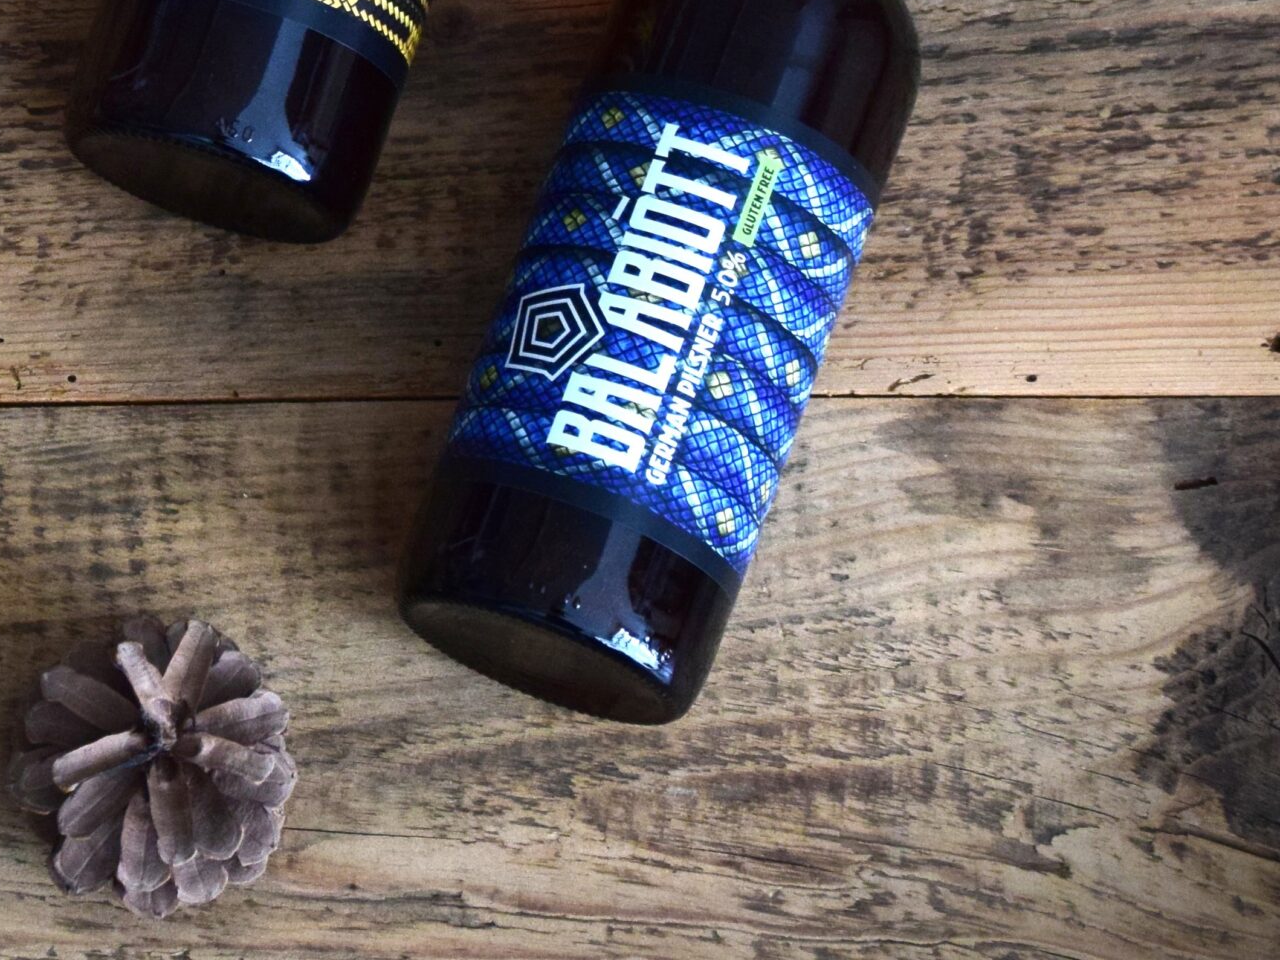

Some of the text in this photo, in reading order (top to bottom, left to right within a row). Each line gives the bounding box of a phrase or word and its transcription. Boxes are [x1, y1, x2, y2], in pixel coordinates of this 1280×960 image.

[741, 166, 775, 235] GLUTEN FREE
[646, 251, 746, 485] GERMAN PILSNER 5.0%
